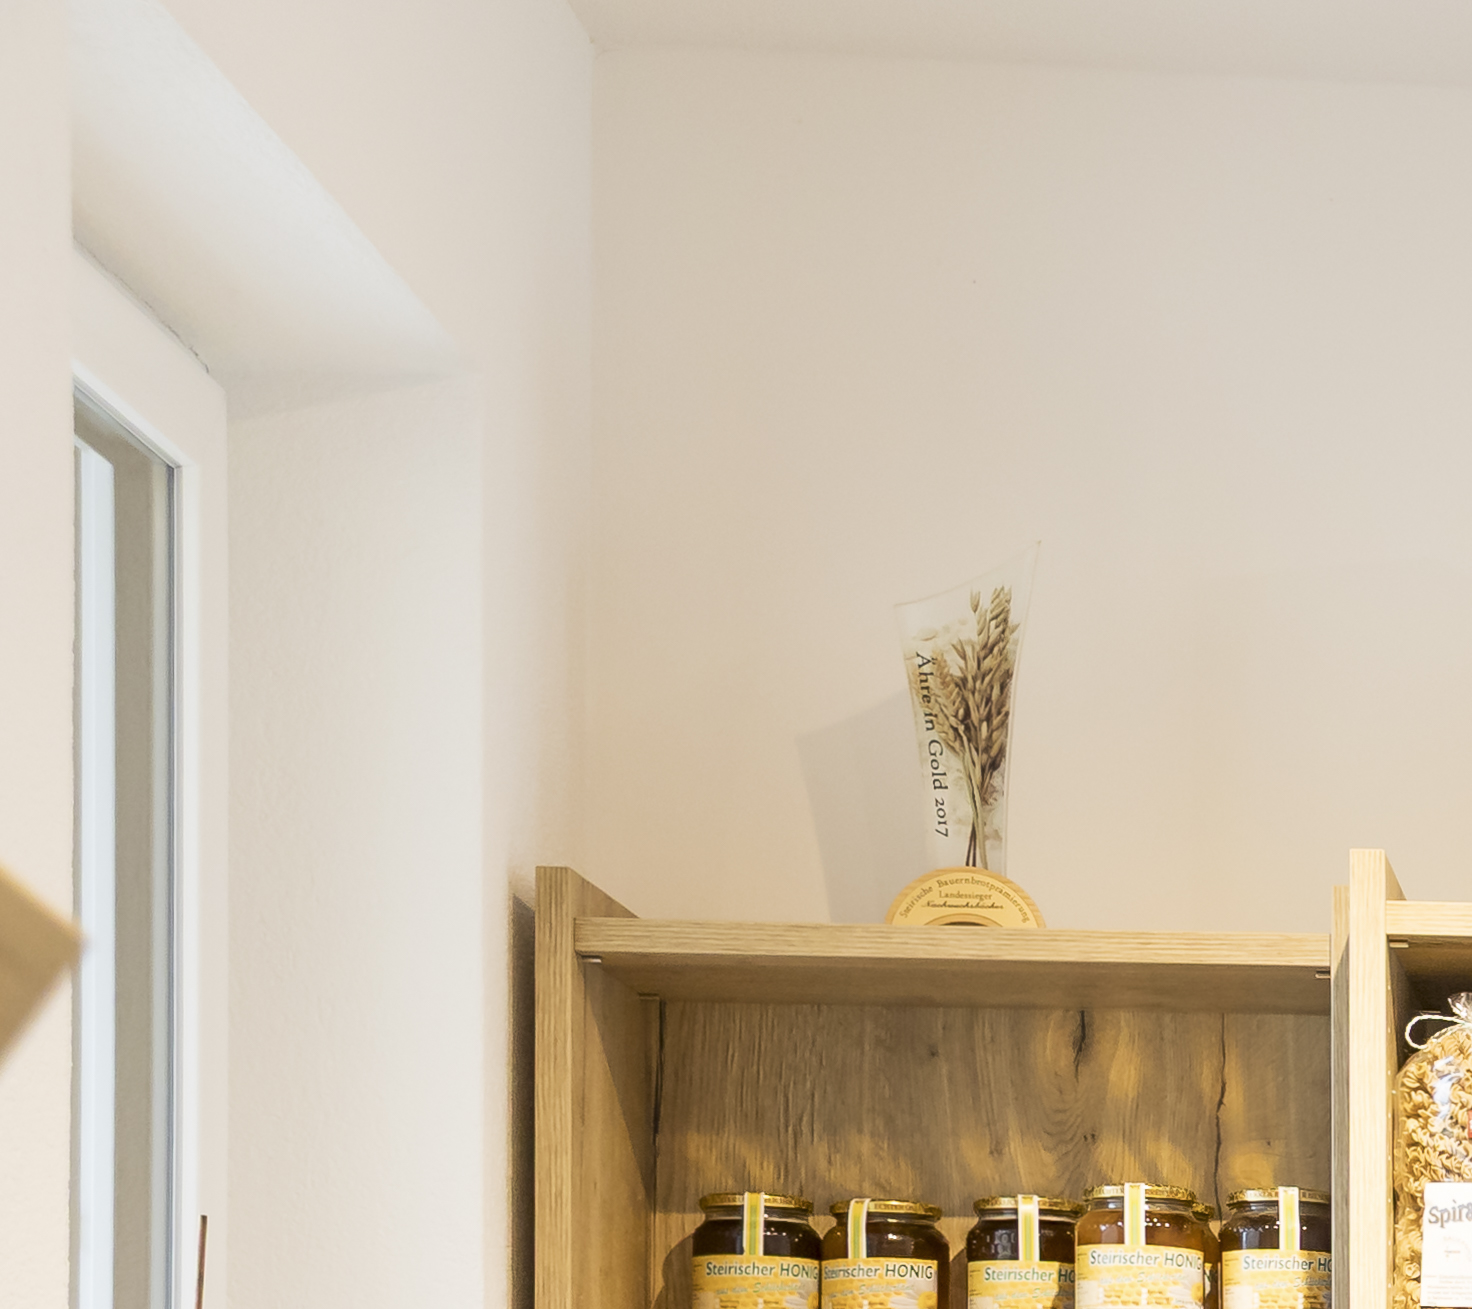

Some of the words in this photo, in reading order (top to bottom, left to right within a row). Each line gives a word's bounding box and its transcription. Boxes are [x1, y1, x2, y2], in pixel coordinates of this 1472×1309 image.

[915, 650, 938, 704] Ähre
[923, 708, 935, 733] in
[927, 739, 949, 791] Gold
[934, 797, 950, 838] 2017
[705, 1260, 775, 1279] Steirischer
[779, 1262, 819, 1281] HONIG
[1089, 1249, 1159, 1268] Steirischer
[1162, 1252, 1203, 1271] HONIG
[1242, 1255, 1312, 1273] Steirischer
[823, 1263, 880, 1281] Steirischer
[884, 1262, 934, 1281] HONIG
[983, 1266, 1055, 1283] Steirischer
